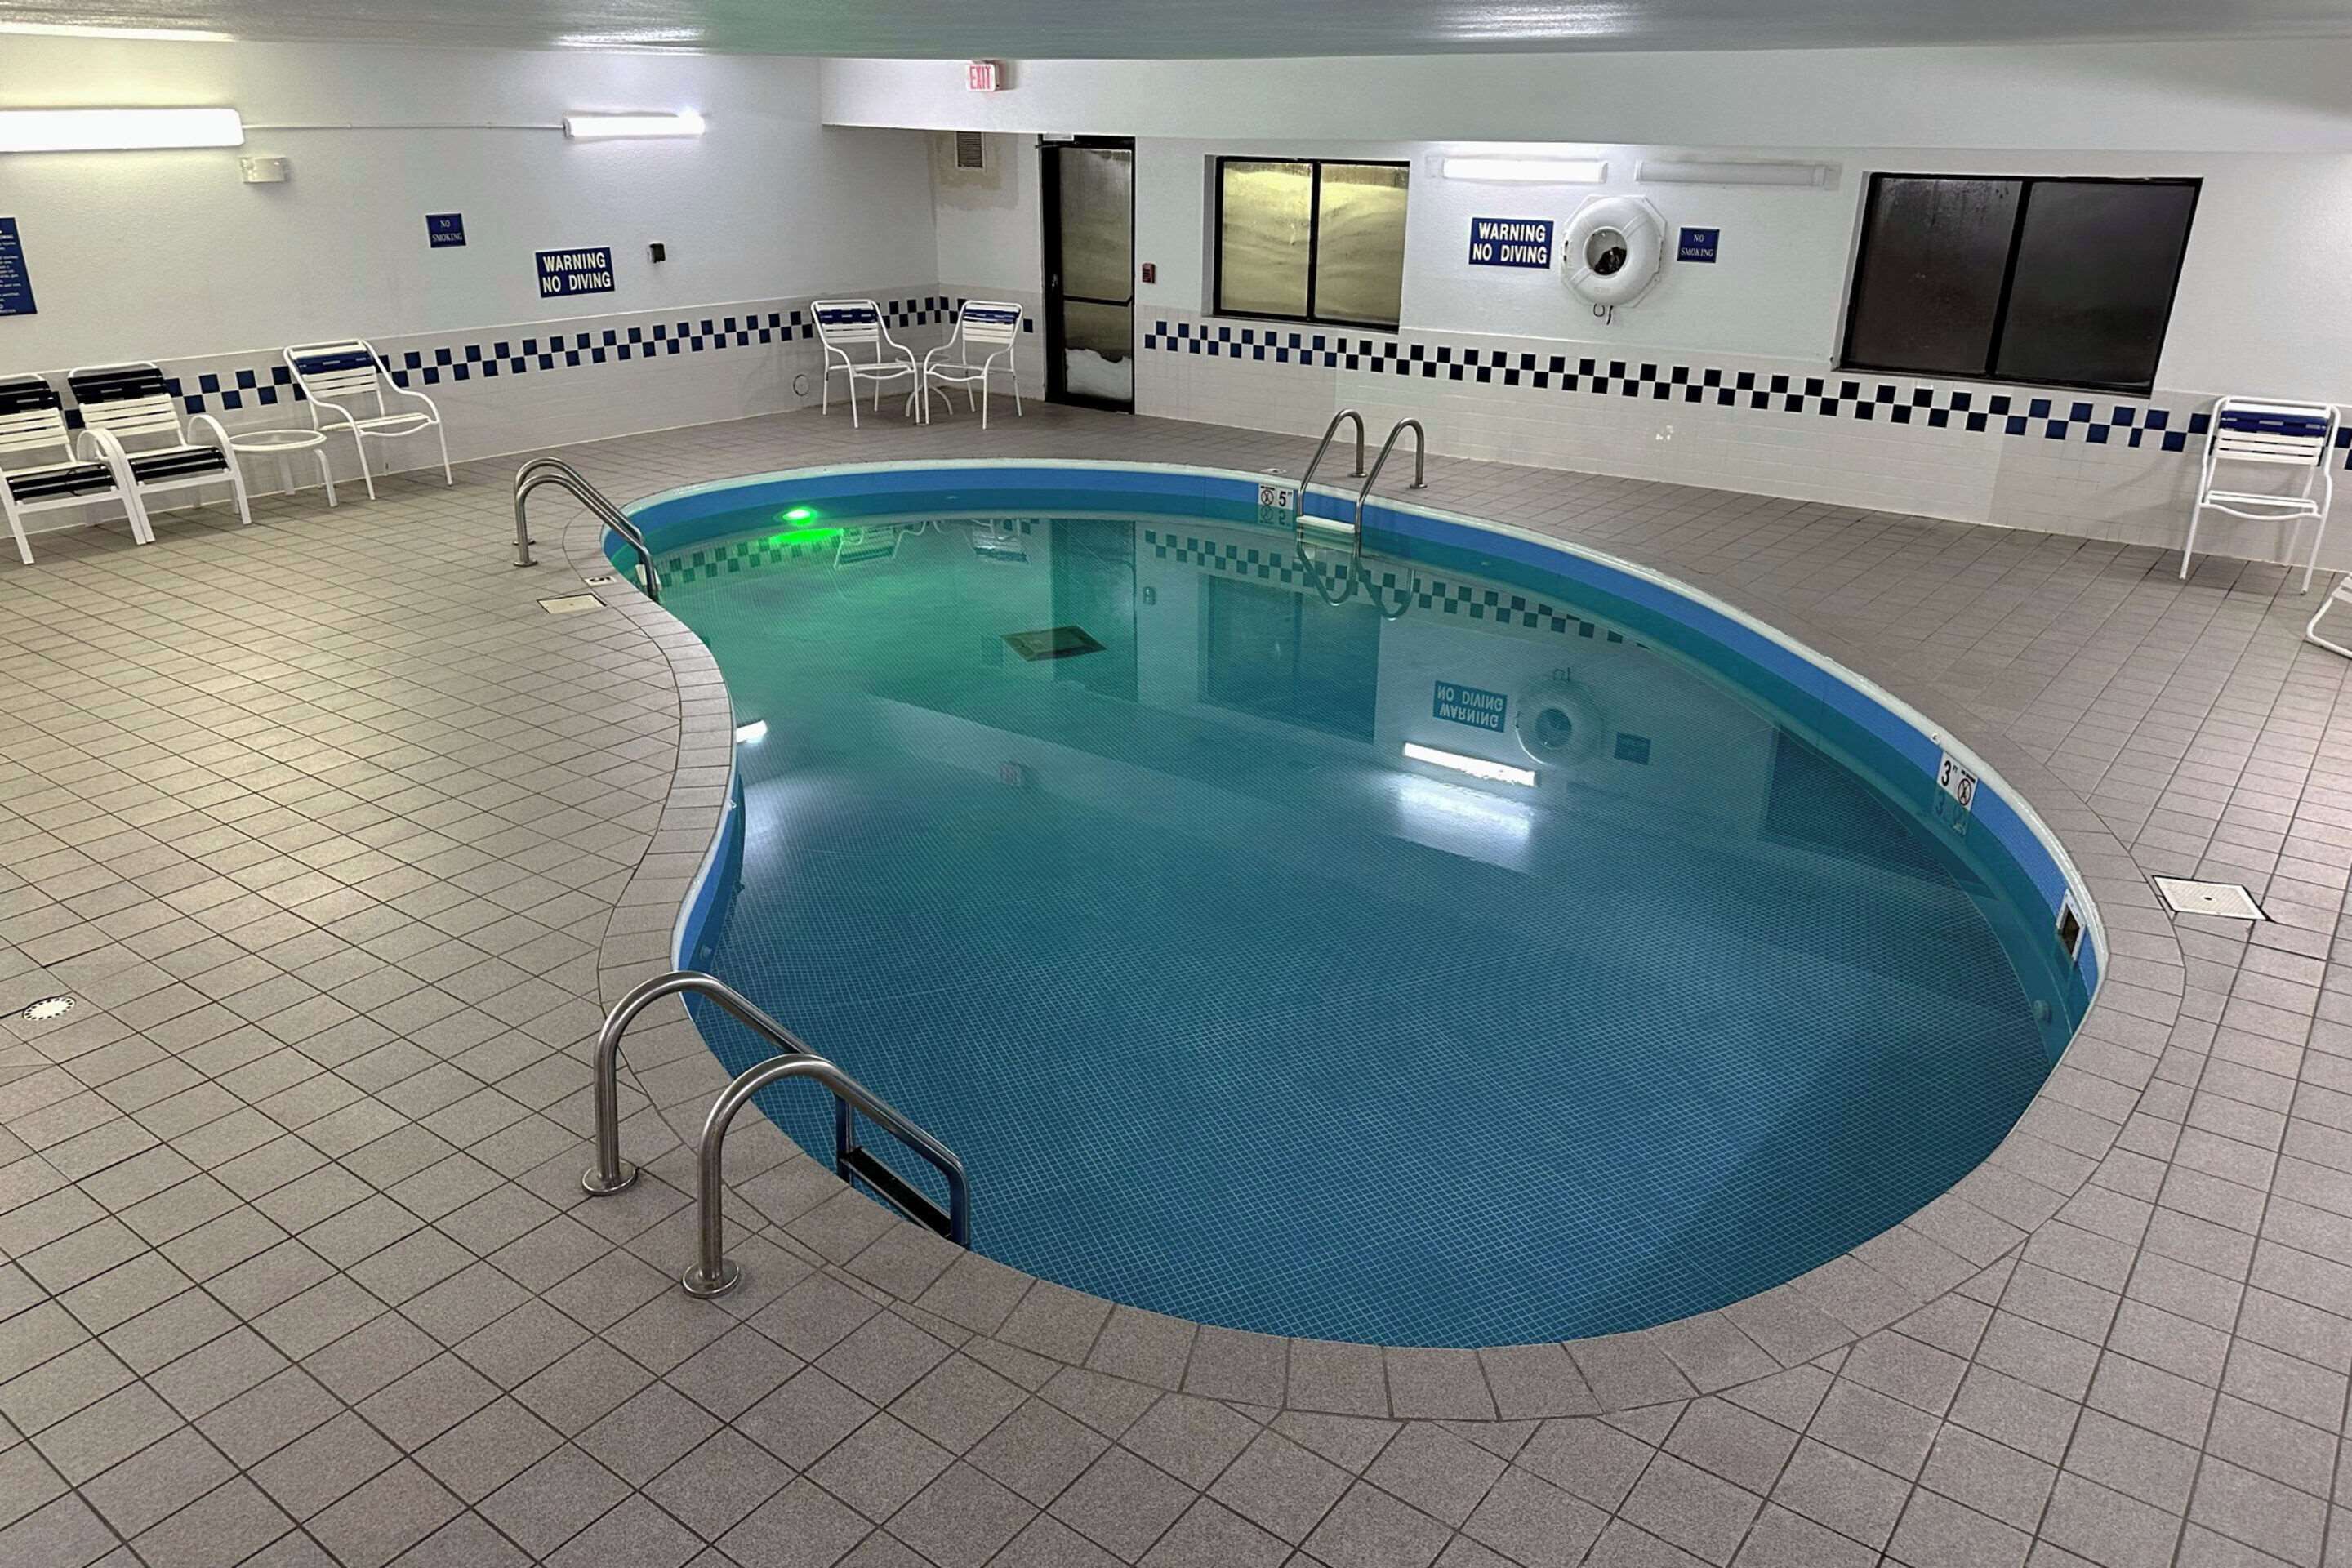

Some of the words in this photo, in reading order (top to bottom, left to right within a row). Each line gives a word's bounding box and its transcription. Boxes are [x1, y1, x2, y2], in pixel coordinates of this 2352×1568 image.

[969, 65, 991, 89] EXIT
[440, 220, 450, 228] NO
[1478, 222, 1546, 243] WARNING
[432, 233, 463, 242] SMOKING
[1693, 234, 1705, 243] NO
[542, 252, 606, 272] WARNING
[1472, 243, 1492, 261] NO
[1500, 245, 1547, 264] DIVING
[1681, 247, 1713, 257] SMOKING
[542, 276, 561, 293] NO
[568, 271, 612, 291] DIVING
[1279, 491, 1287, 507] 5
[1941, 760, 1951, 786] 3
